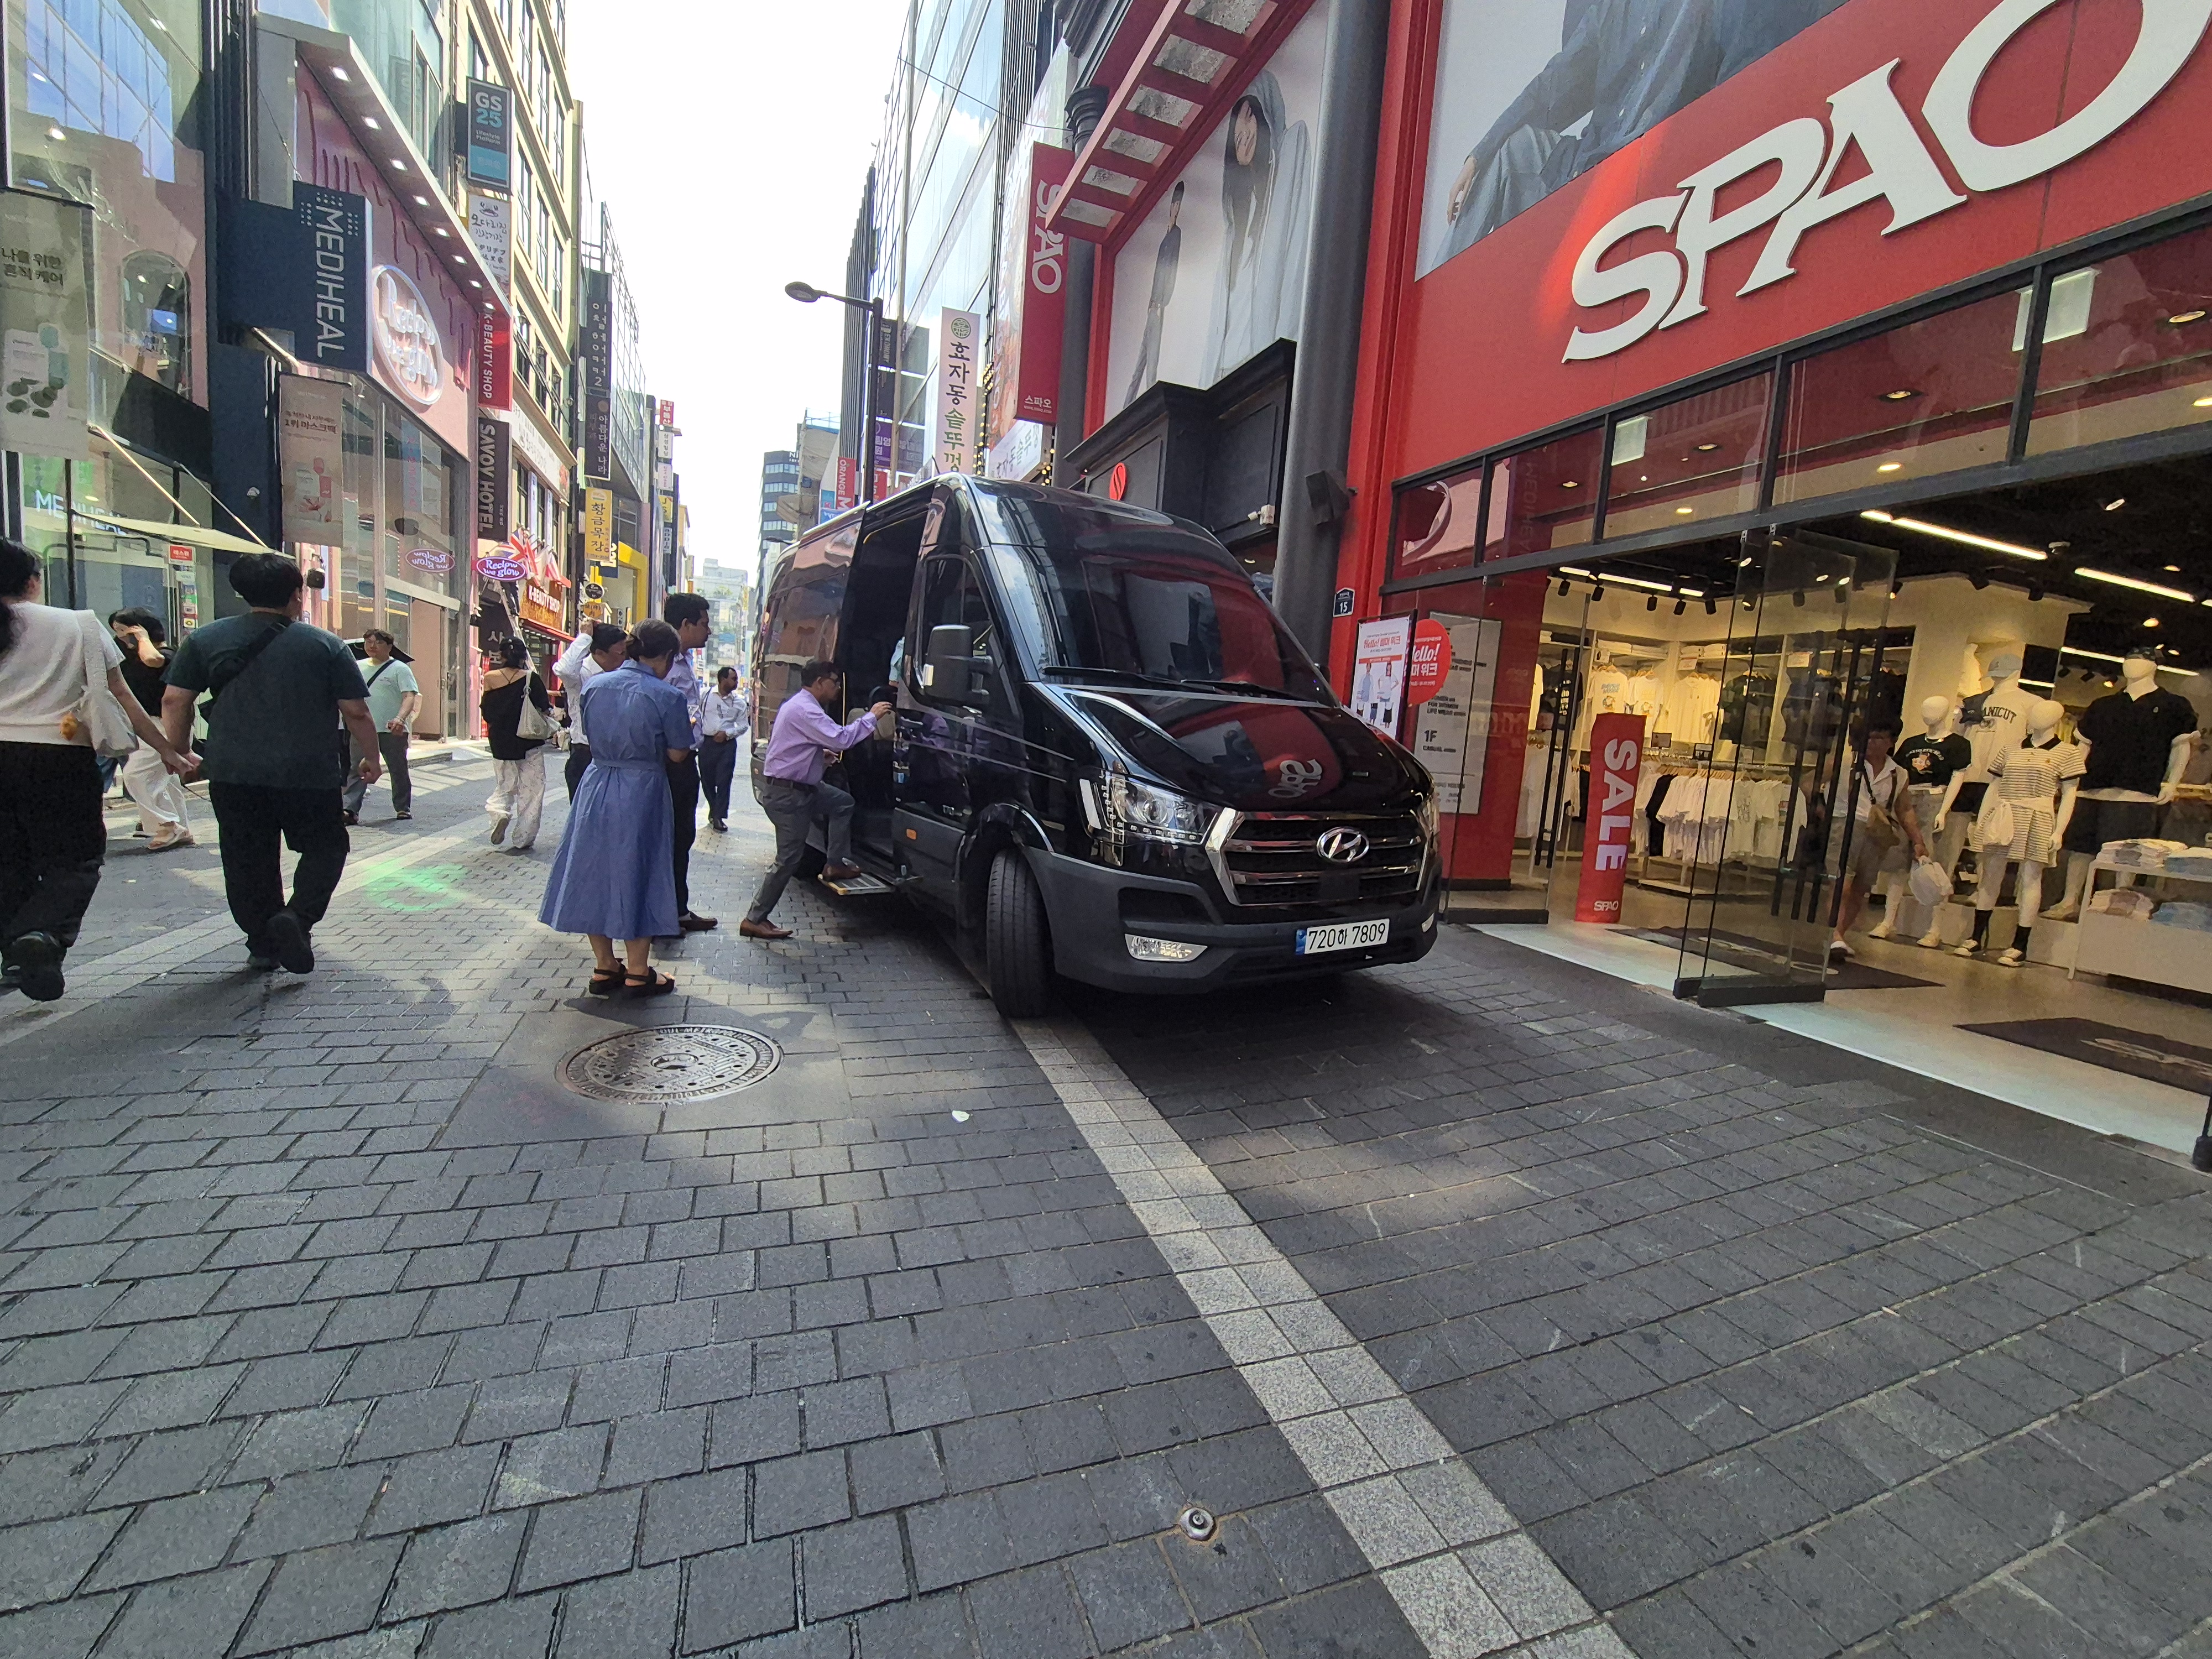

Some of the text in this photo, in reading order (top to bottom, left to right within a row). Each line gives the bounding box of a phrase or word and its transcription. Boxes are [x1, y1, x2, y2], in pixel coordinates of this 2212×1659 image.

[476, 91, 502, 112] GS
[476, 107, 502, 128] 25
[1561, 0, 2211, 364] SPAO
[315, 202, 346, 359] MEDIHEAL
[482, 311, 493, 399] K-BEAUTY SHOP
[1024, 394, 1052, 408] 스파오
[478, 424, 496, 532] SAVOY HOTEL
[838, 460, 846, 496] ORANGE
[591, 503, 606, 552] 황금목장
[486, 559, 518, 570] Reclow
[497, 567, 520, 577] glow
[1340, 601, 1348, 614] 15
[1412, 643, 1441, 662] ello!
[1421, 663, 1437, 677] 위크
[1424, 729, 1437, 742] 1F
[1595, 738, 1637, 871] SALE
[1594, 899, 1619, 912] SPAO
[1309, 923, 1385, 950] 720하 7809
